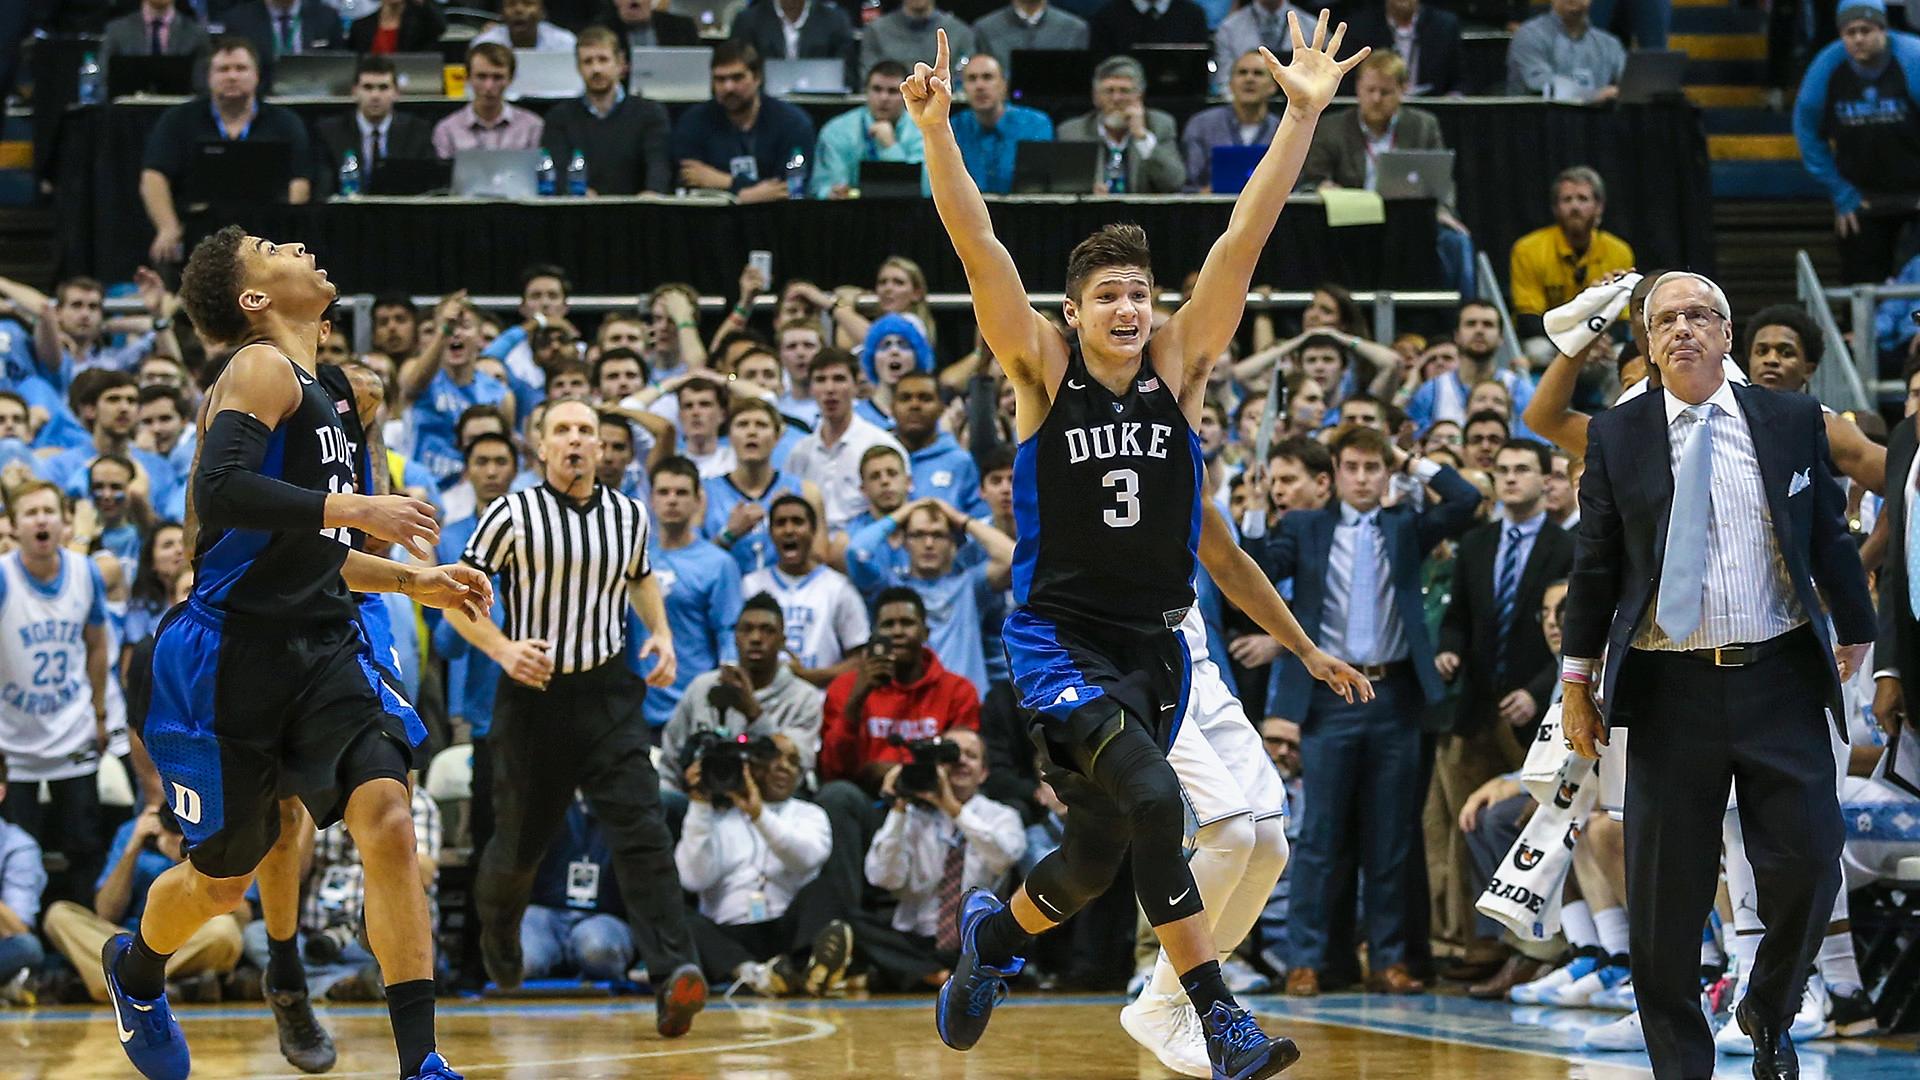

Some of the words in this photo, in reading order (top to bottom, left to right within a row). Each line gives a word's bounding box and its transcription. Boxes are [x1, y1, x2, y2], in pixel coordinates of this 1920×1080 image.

[1065, 422, 1172, 464] DUKE
[1102, 468, 1140, 528] 3
[33, 649, 68, 686] 23
[171, 781, 201, 824] D
